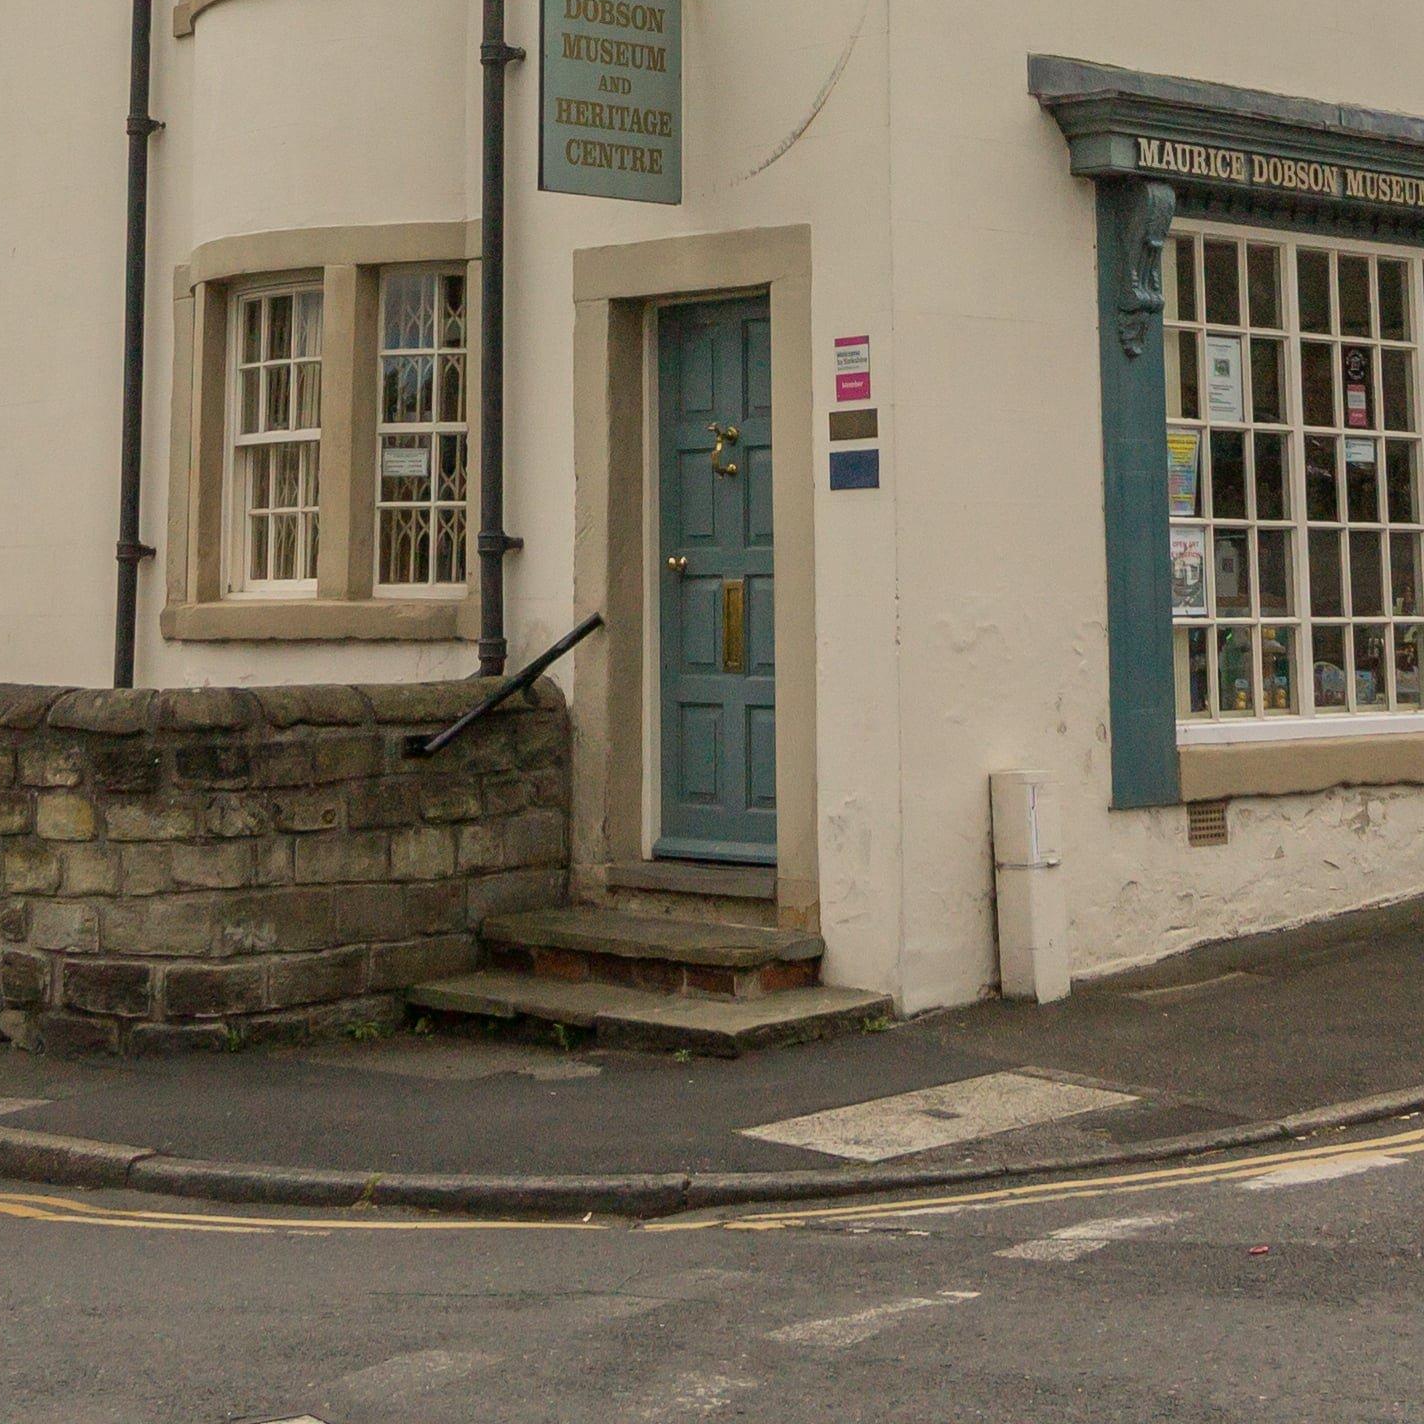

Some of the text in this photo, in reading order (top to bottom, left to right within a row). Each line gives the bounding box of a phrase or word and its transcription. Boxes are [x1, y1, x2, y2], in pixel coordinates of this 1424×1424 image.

[561, 32, 667, 73] MUSEUM
[597, 74, 632, 95] AND
[555, 96, 672, 138] HERITAGE
[565, 137, 663, 175] CENTRE
[1137, 137, 1245, 182] MAURICE
[1252, 154, 1339, 195] DOBSON
